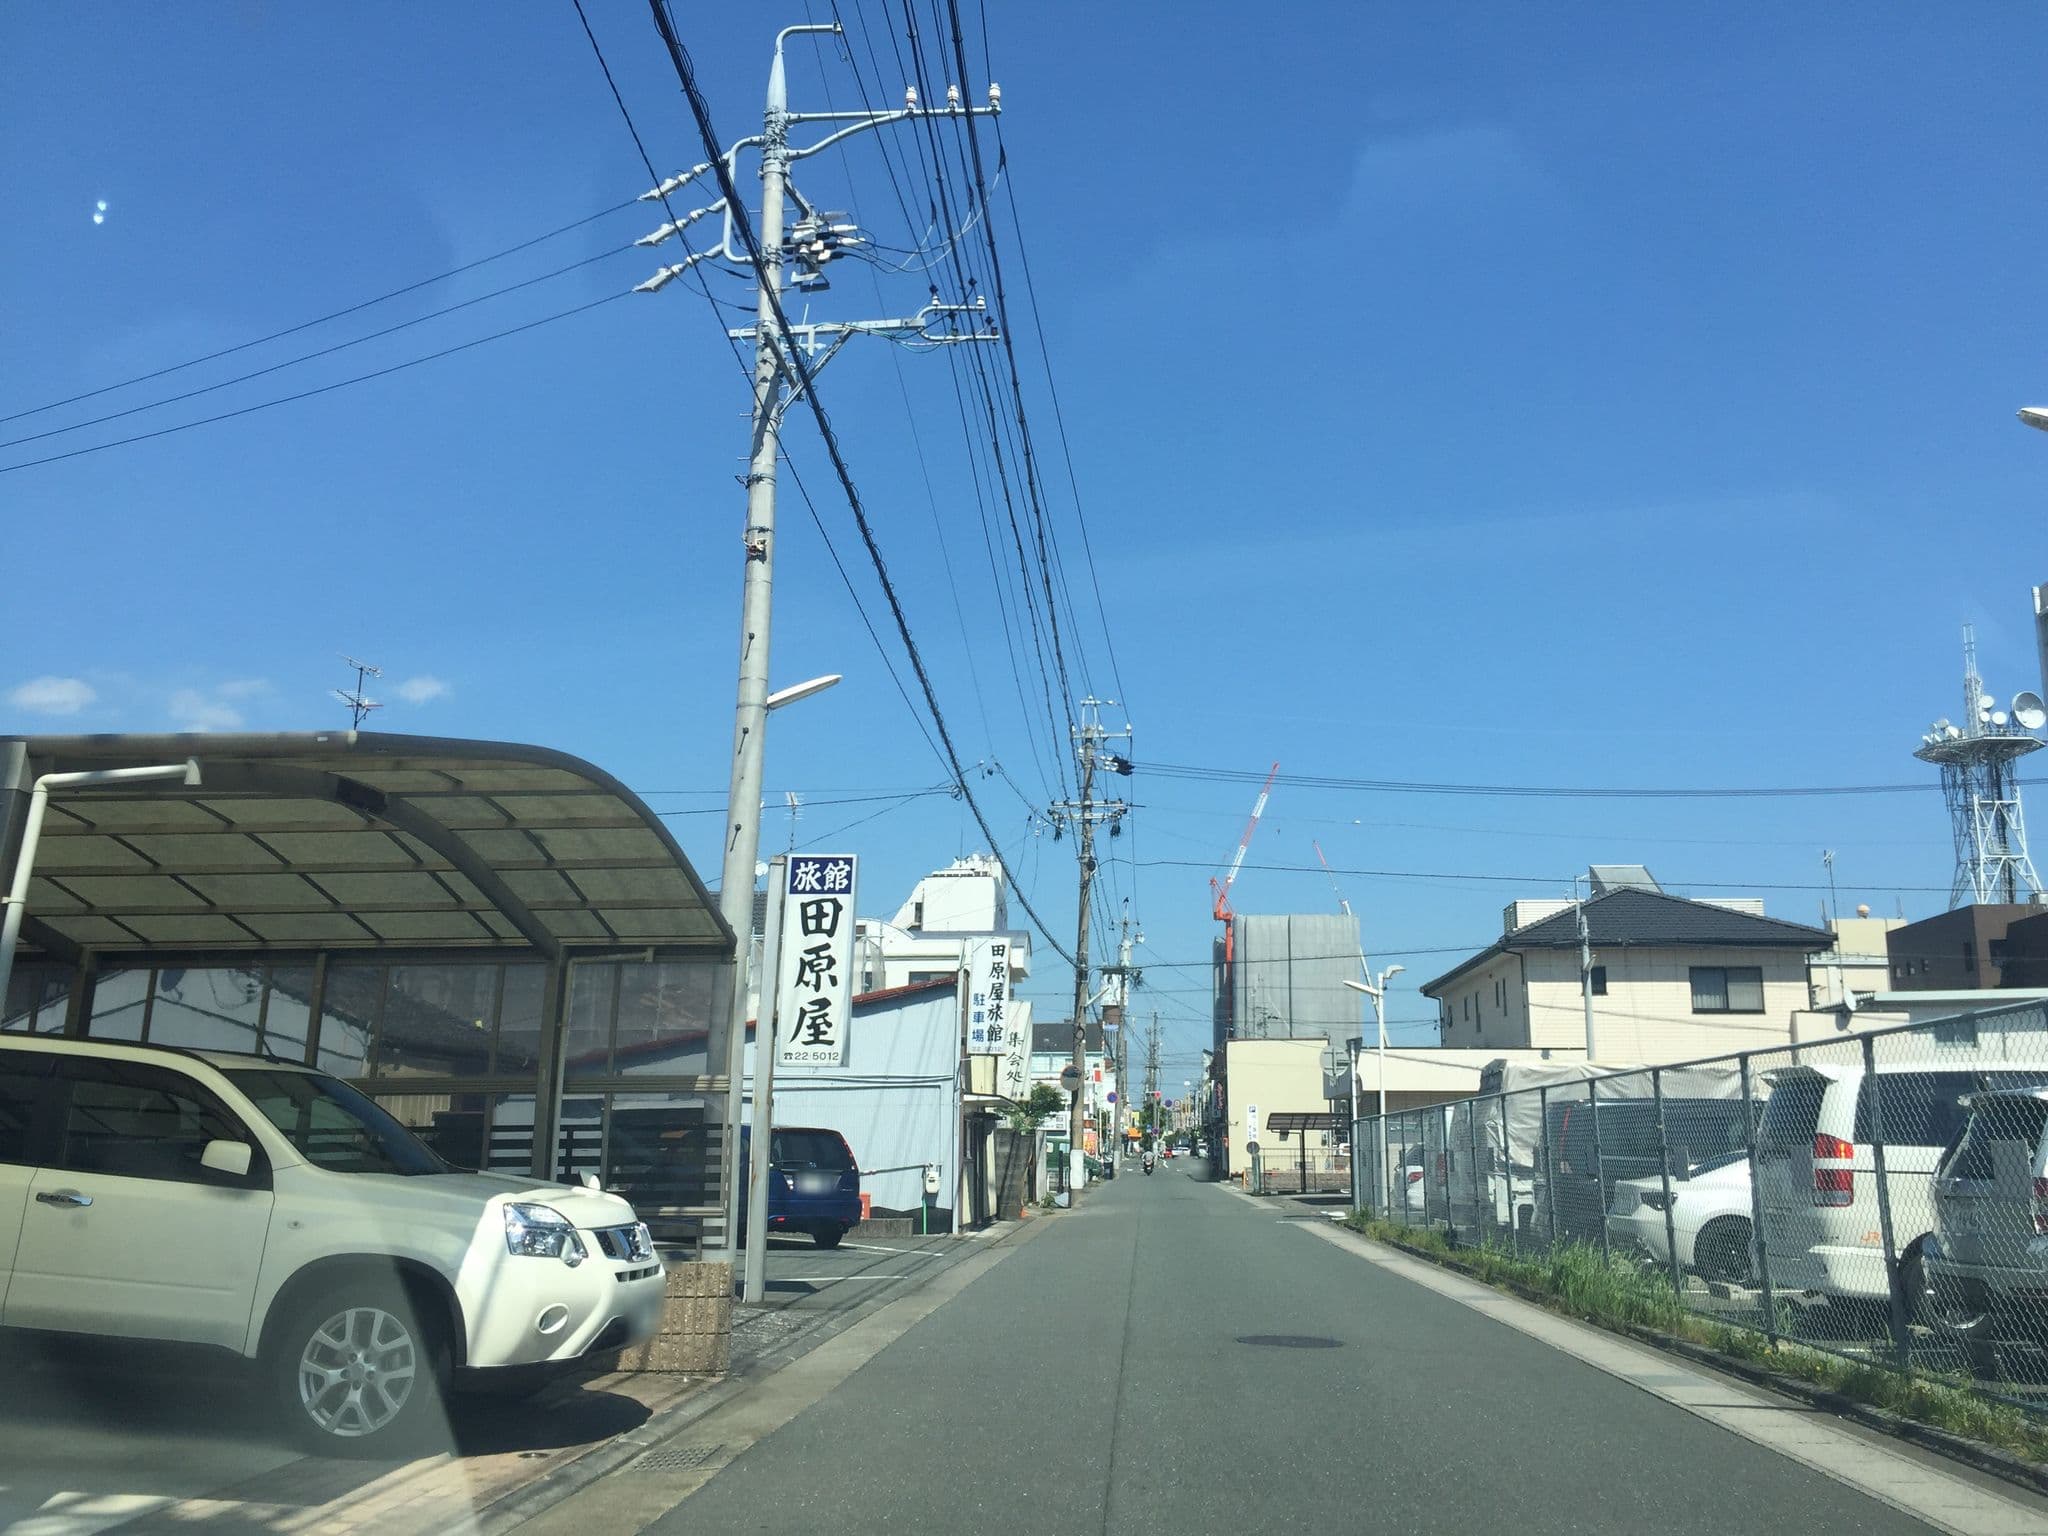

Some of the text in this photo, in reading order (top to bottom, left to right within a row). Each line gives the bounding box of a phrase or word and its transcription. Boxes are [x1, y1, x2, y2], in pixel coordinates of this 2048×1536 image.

[792, 860, 851, 892] 旅館
[789, 896, 843, 1046] 田原屋
[986, 943, 1006, 1043] 田原屋旅館
[971, 992, 985, 1043] 駐車場
